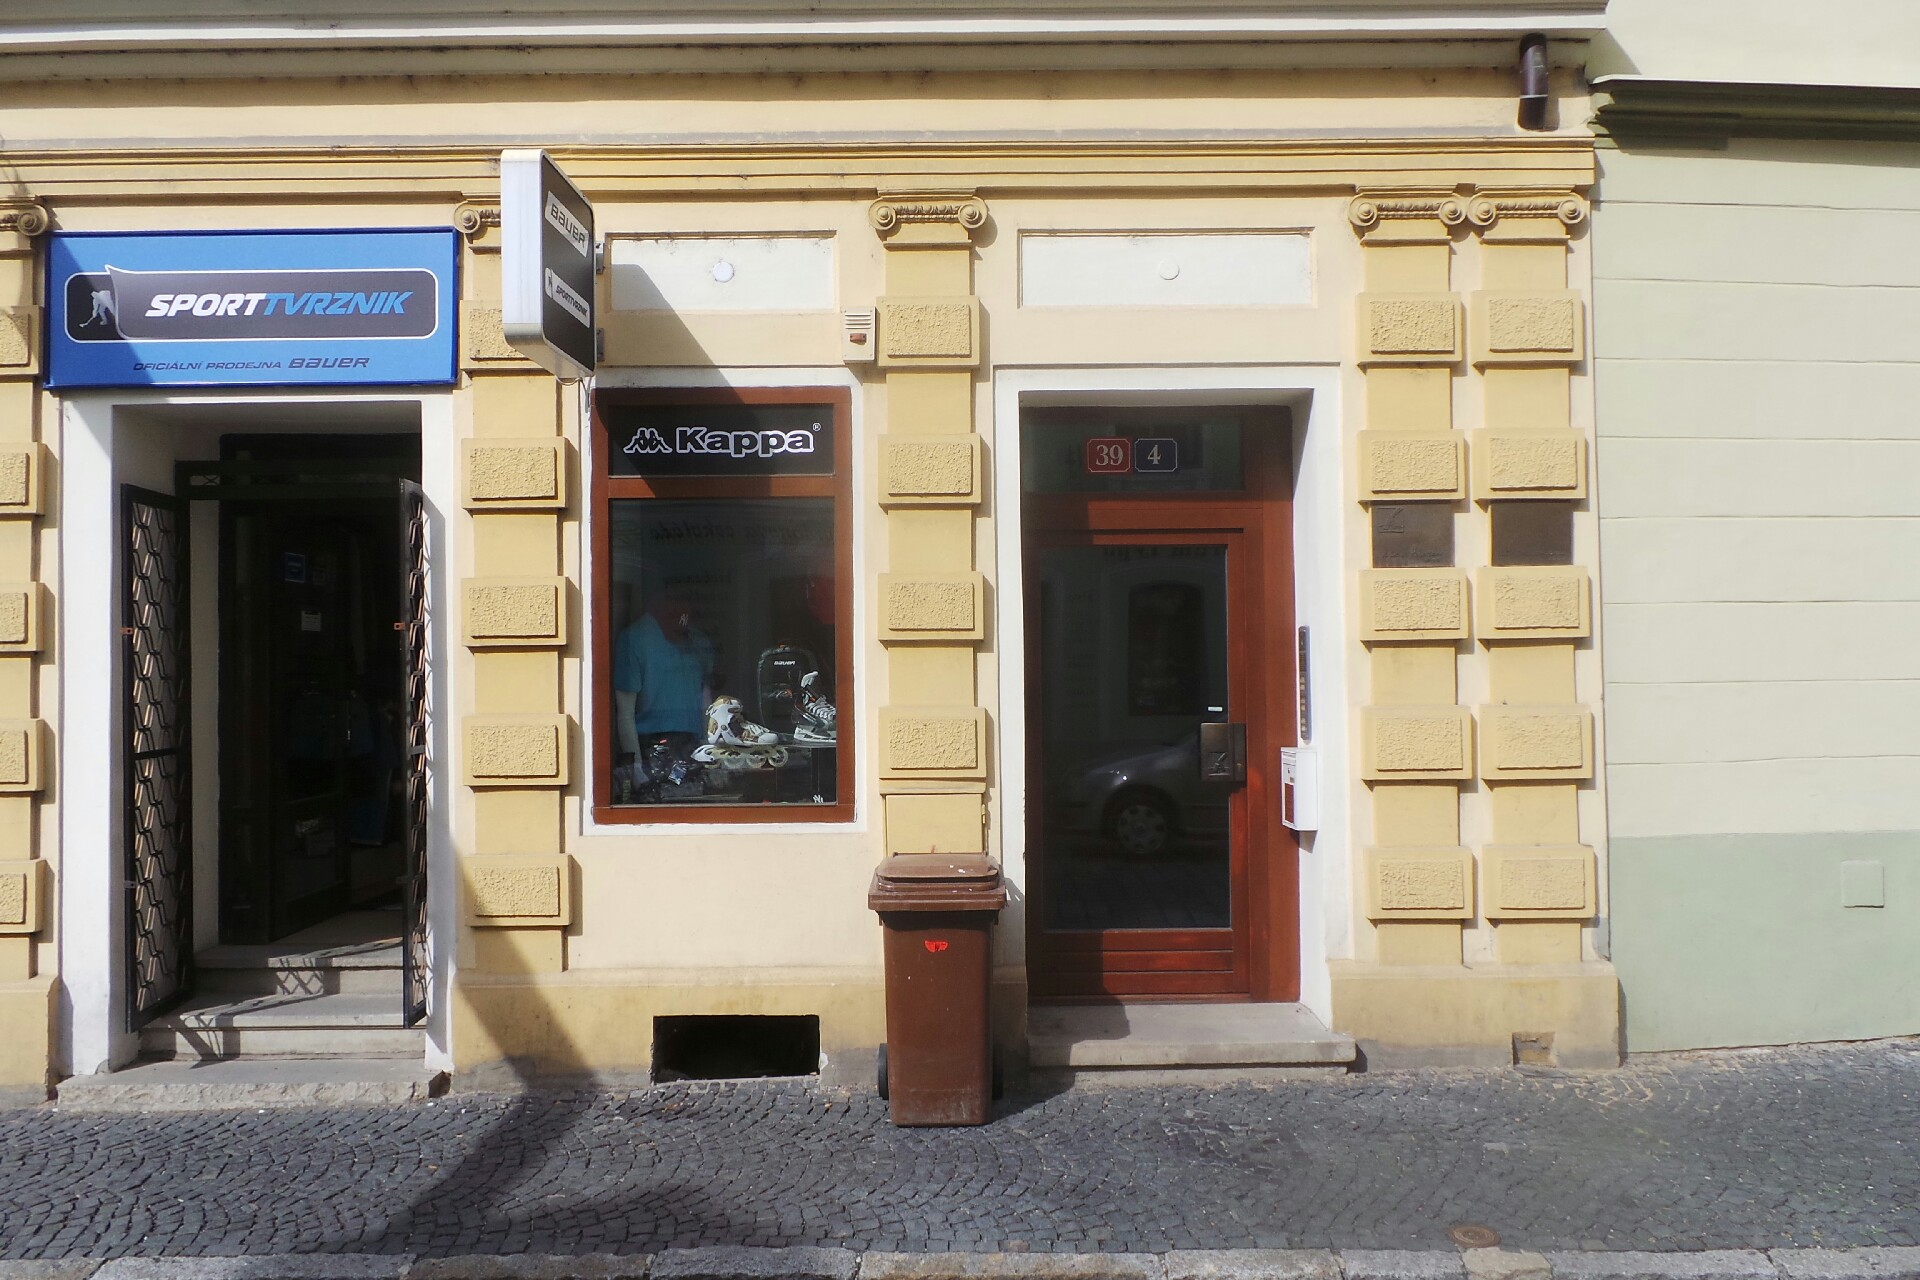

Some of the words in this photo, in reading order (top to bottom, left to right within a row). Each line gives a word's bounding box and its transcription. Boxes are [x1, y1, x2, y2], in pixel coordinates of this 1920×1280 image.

[550, 203, 586, 249] BAUER
[145, 291, 413, 317] SPORTTVRZNIK
[133, 361, 203, 371] OFICIÁLNÍ
[205, 361, 282, 371] PRODEJNA
[288, 357, 370, 369] BAUER
[676, 426, 814, 458] Kappa
[1095, 444, 1124, 466] 39
[1147, 444, 1162, 465] 4
